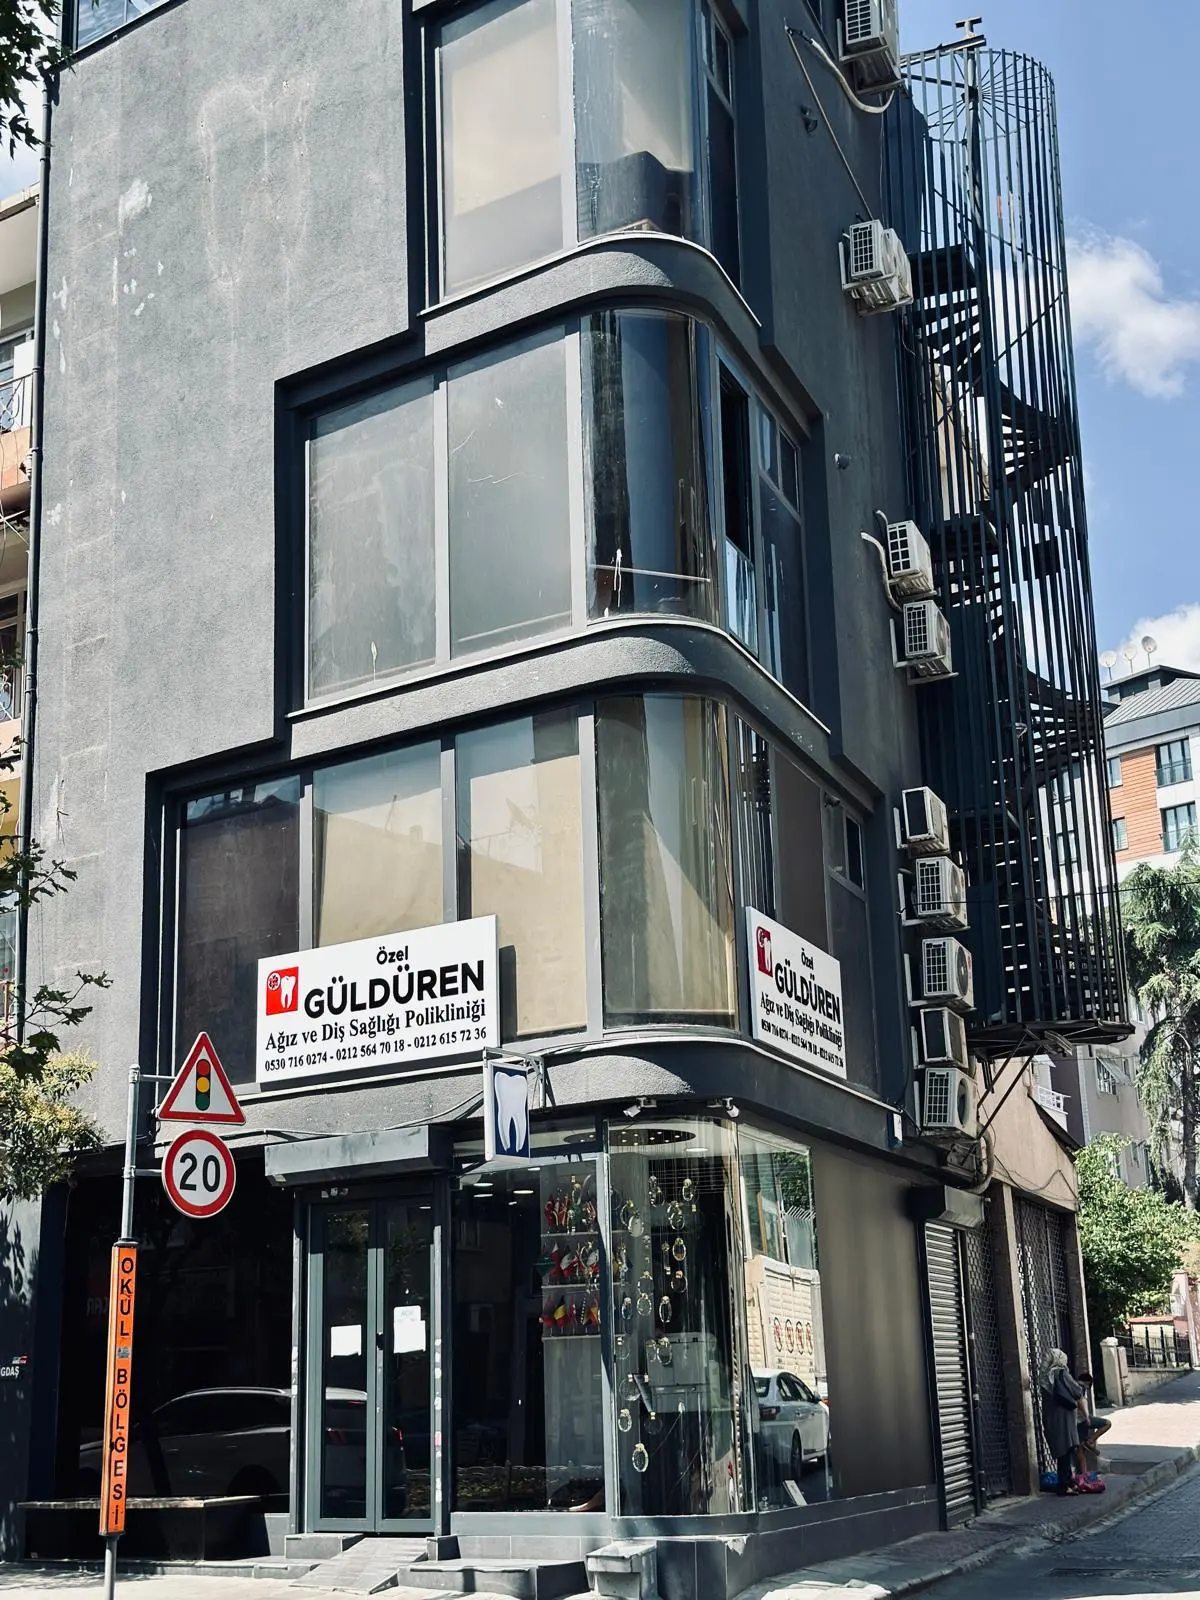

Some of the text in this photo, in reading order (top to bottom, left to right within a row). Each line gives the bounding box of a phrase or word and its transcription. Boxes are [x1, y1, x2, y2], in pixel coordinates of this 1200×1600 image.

[376, 945, 409, 965] Özel
[801, 947, 814, 970] Özel
[304, 959, 484, 1018] GÜLDÜREN
[760, 991, 775, 1015] Ağız
[776, 1003, 783, 1017] ve
[784, 1002, 795, 1027] Diş
[774, 958, 841, 1024] GÜLDÜREN
[265, 998, 486, 1053] Ağız ve Diş Sağlığı Polikliniği
[265, 1058, 286, 1071] 0530
[288, 1055, 304, 1068] 716
[306, 1051, 327, 1065] 0274
[336, 1046, 357, 1060] 0212
[360, 1043, 377, 1057] 564
[380, 1041, 391, 1054] 70
[394, 1039, 405, 1052] 18
[414, 1034, 437, 1048] 0212
[440, 1031, 457, 1045] 615
[460, 1029, 471, 1042] 72
[474, 1026, 487, 1040] 36
[180, 1152, 220, 1192] 20
[120, 1257, 134, 1336] OKUL
[113, 1368, 128, 1525] BÖLGESİ
